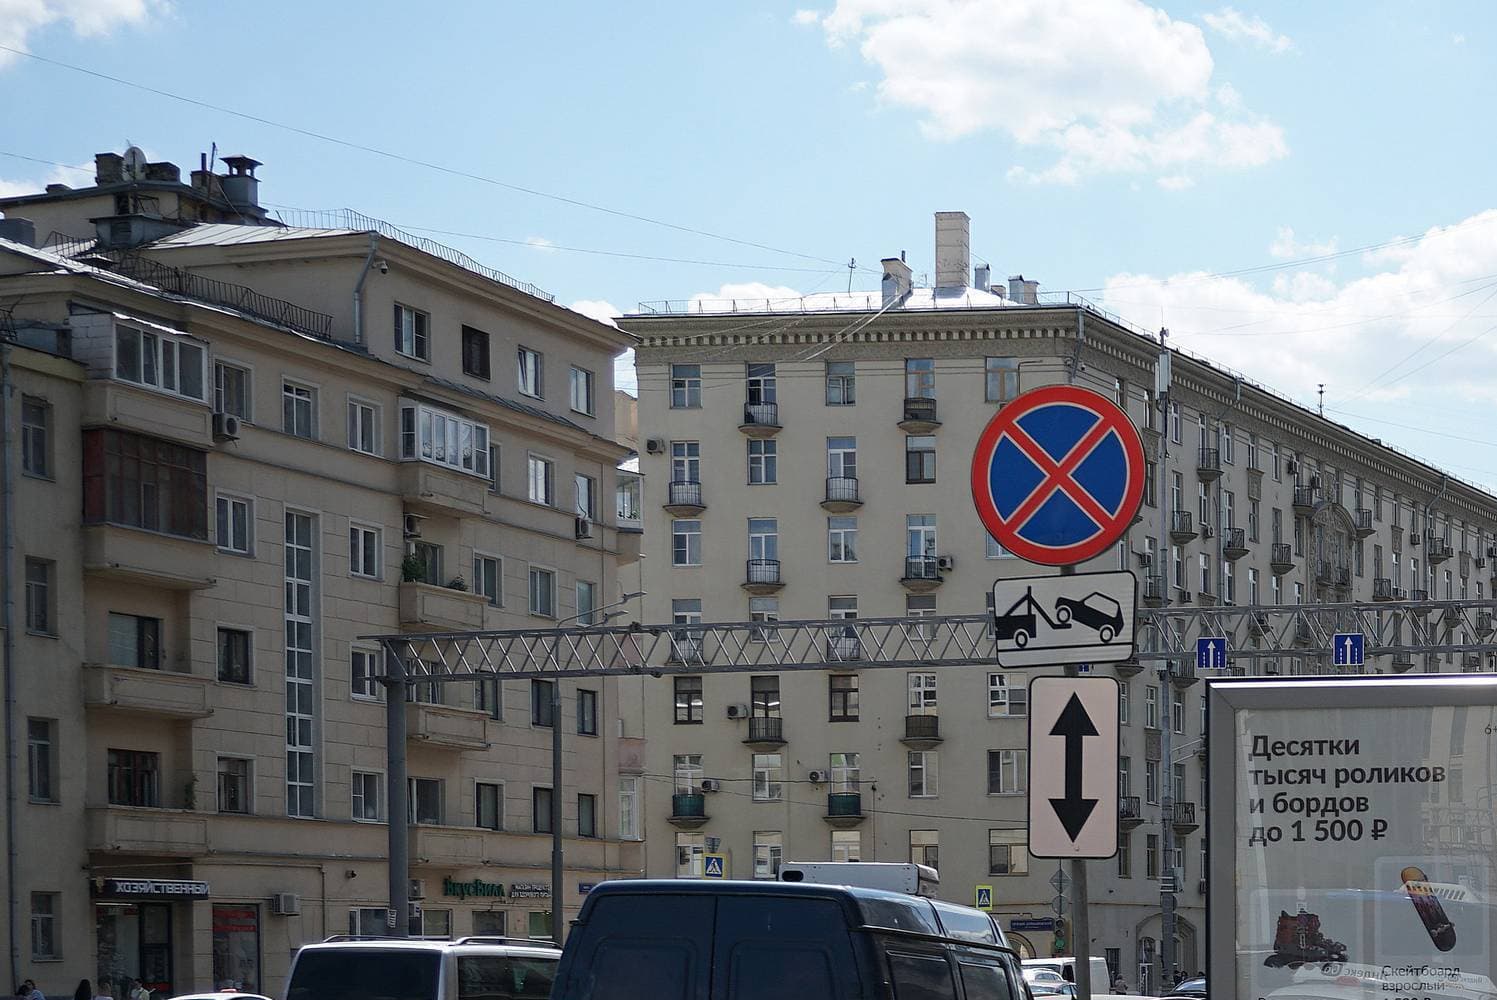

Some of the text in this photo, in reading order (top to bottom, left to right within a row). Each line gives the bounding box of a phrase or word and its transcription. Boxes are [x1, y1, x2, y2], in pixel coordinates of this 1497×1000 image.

[1250, 735, 1360, 760] Десятки
[1249, 766, 1446, 788] тысяч роликов
[1250, 792, 1369, 817] и бордов
[1249, 825, 1282, 847] до
[1291, 820, 1305, 841] 1
[1315, 819, 1363, 841] 500
[115, 880, 210, 895] ХОЗЯЙСТВЕННЫЙ
[1382, 981, 1445, 993] взрослый
